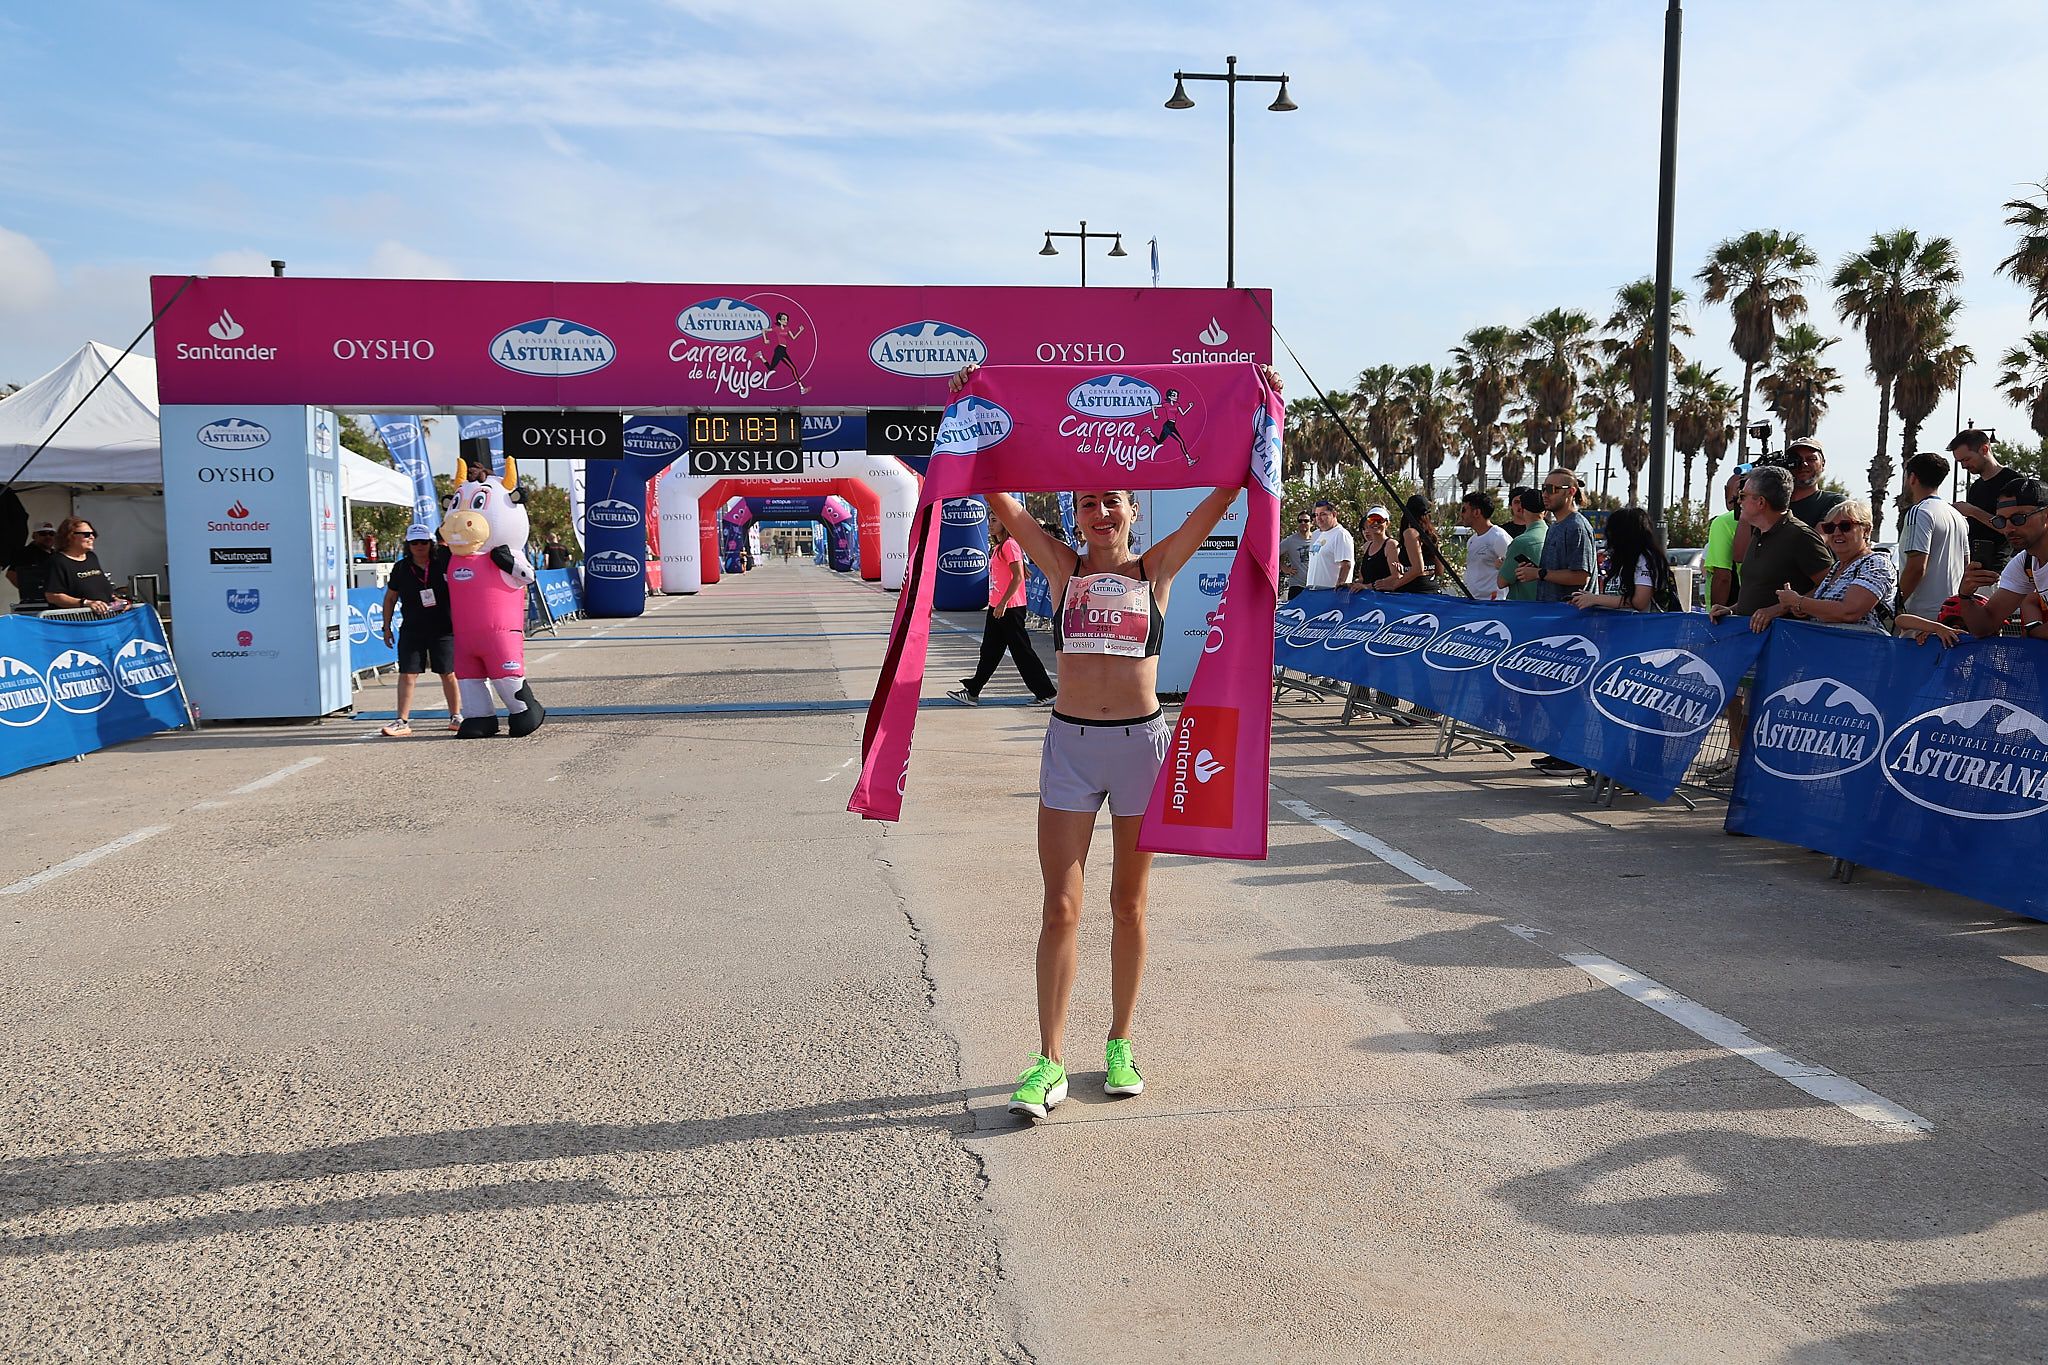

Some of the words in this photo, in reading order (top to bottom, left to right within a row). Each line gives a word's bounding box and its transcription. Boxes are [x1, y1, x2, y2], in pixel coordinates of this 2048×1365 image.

[684, 314, 764, 331] ASTURIANA
[176, 342, 278, 361] Santander
[333, 338, 435, 361] OYSHO
[500, 339, 606, 361] ASTURIANA
[669, 338, 747, 363] Carrera
[879, 345, 979, 363] ASTURIANA
[1036, 342, 1125, 363] OYSHO
[1171, 348, 1256, 364] Santander
[687, 363, 704, 380] de
[706, 363, 717, 380] la
[714, 359, 776, 399] Mujer
[1074, 390, 1153, 407] ASTURIANA
[203, 430, 266, 443] ASTURIANA
[522, 428, 607, 446] OYSHO
[695, 417, 794, 442] 00:18:31
[885, 424, 938, 442] OYSH
[1058, 415, 1136, 438] Carrera
[694, 450, 799, 473] OYSHO
[1077, 438, 1093, 454] de
[1094, 438, 1104, 454] la
[1102, 434, 1164, 472] Mujer
[198, 467, 274, 483] OYSHO
[207, 520, 271, 532] Santander
[589, 510, 637, 522] ASTURIANA
[662, 513, 693, 521] OYSHO
[214, 551, 268, 563] Neutrogena
[589, 561, 637, 573] ASTURIANA
[663, 555, 693, 563] OYSHO
[1088, 609, 1122, 624] 016
[1111, 644, 1139, 652] Santander
[1429, 634, 1499, 664] ASTURIANA
[1529, 647, 1558, 659] CENTRAL
[1498, 646, 1581, 686] ASTURIANA
[52, 674, 112, 701] ASTURIANA
[1628, 667, 1669, 687] CENTRAL
[1671, 677, 1715, 701] LECHERA
[0, 686, 47, 712] STURIANA
[1595, 665, 1710, 726] ASTURIANA
[1777, 708, 1819, 723] CENTRAL
[1822, 714, 1871, 731] LECHERA
[1756, 709, 1867, 762] ASTURIANA
[1930, 731, 1989, 752] CENTRAL
[1992, 741, 2048, 763] LECHER
[1172, 716, 1196, 814] Santander
